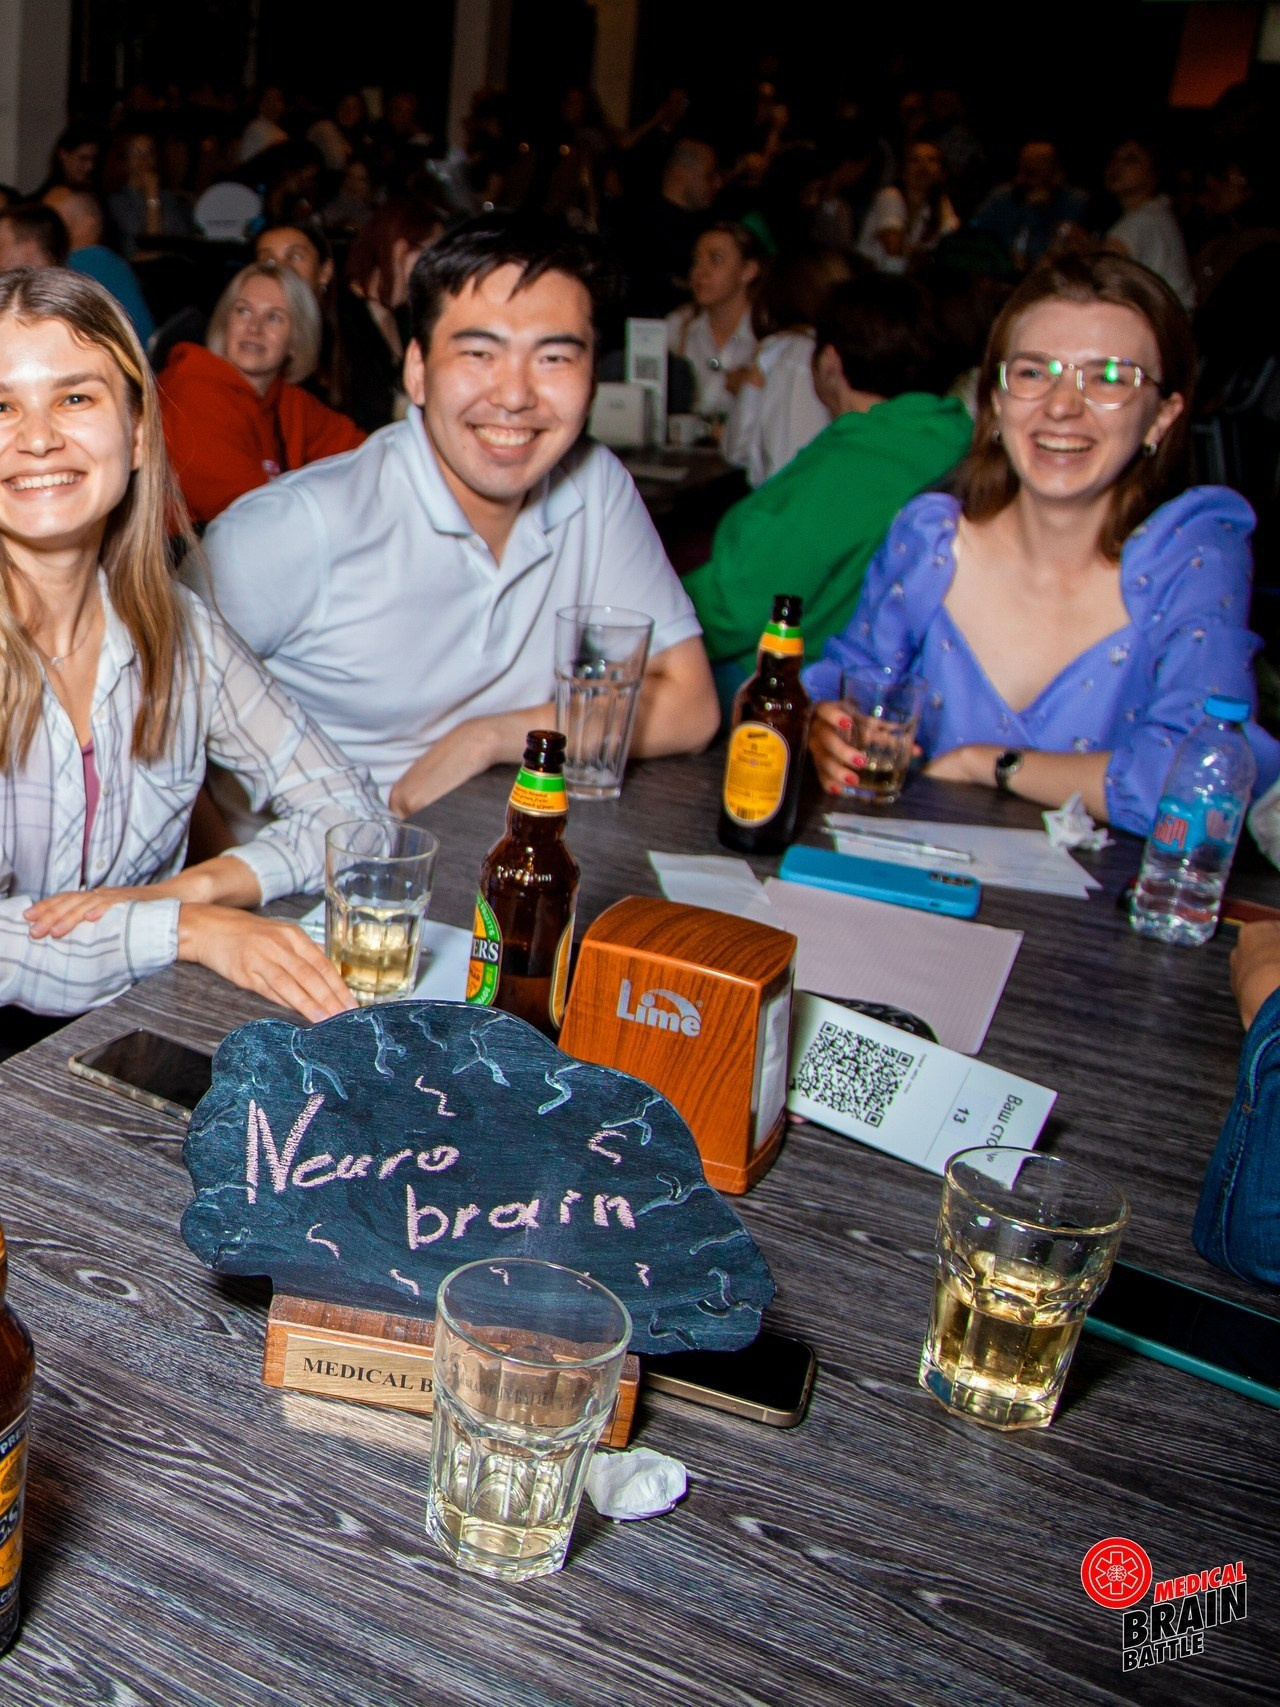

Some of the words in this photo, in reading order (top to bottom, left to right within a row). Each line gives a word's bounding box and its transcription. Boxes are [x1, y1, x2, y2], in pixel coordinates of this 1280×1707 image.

[616, 978, 701, 1037] Lime
[953, 1107, 970, 1124] 13
[998, 1094, 1023, 1124] Ваш
[246, 1093, 460, 1204] Neuro
[407, 1184, 636, 1250] brain
[303, 1357, 413, 1391] MEDICAL
